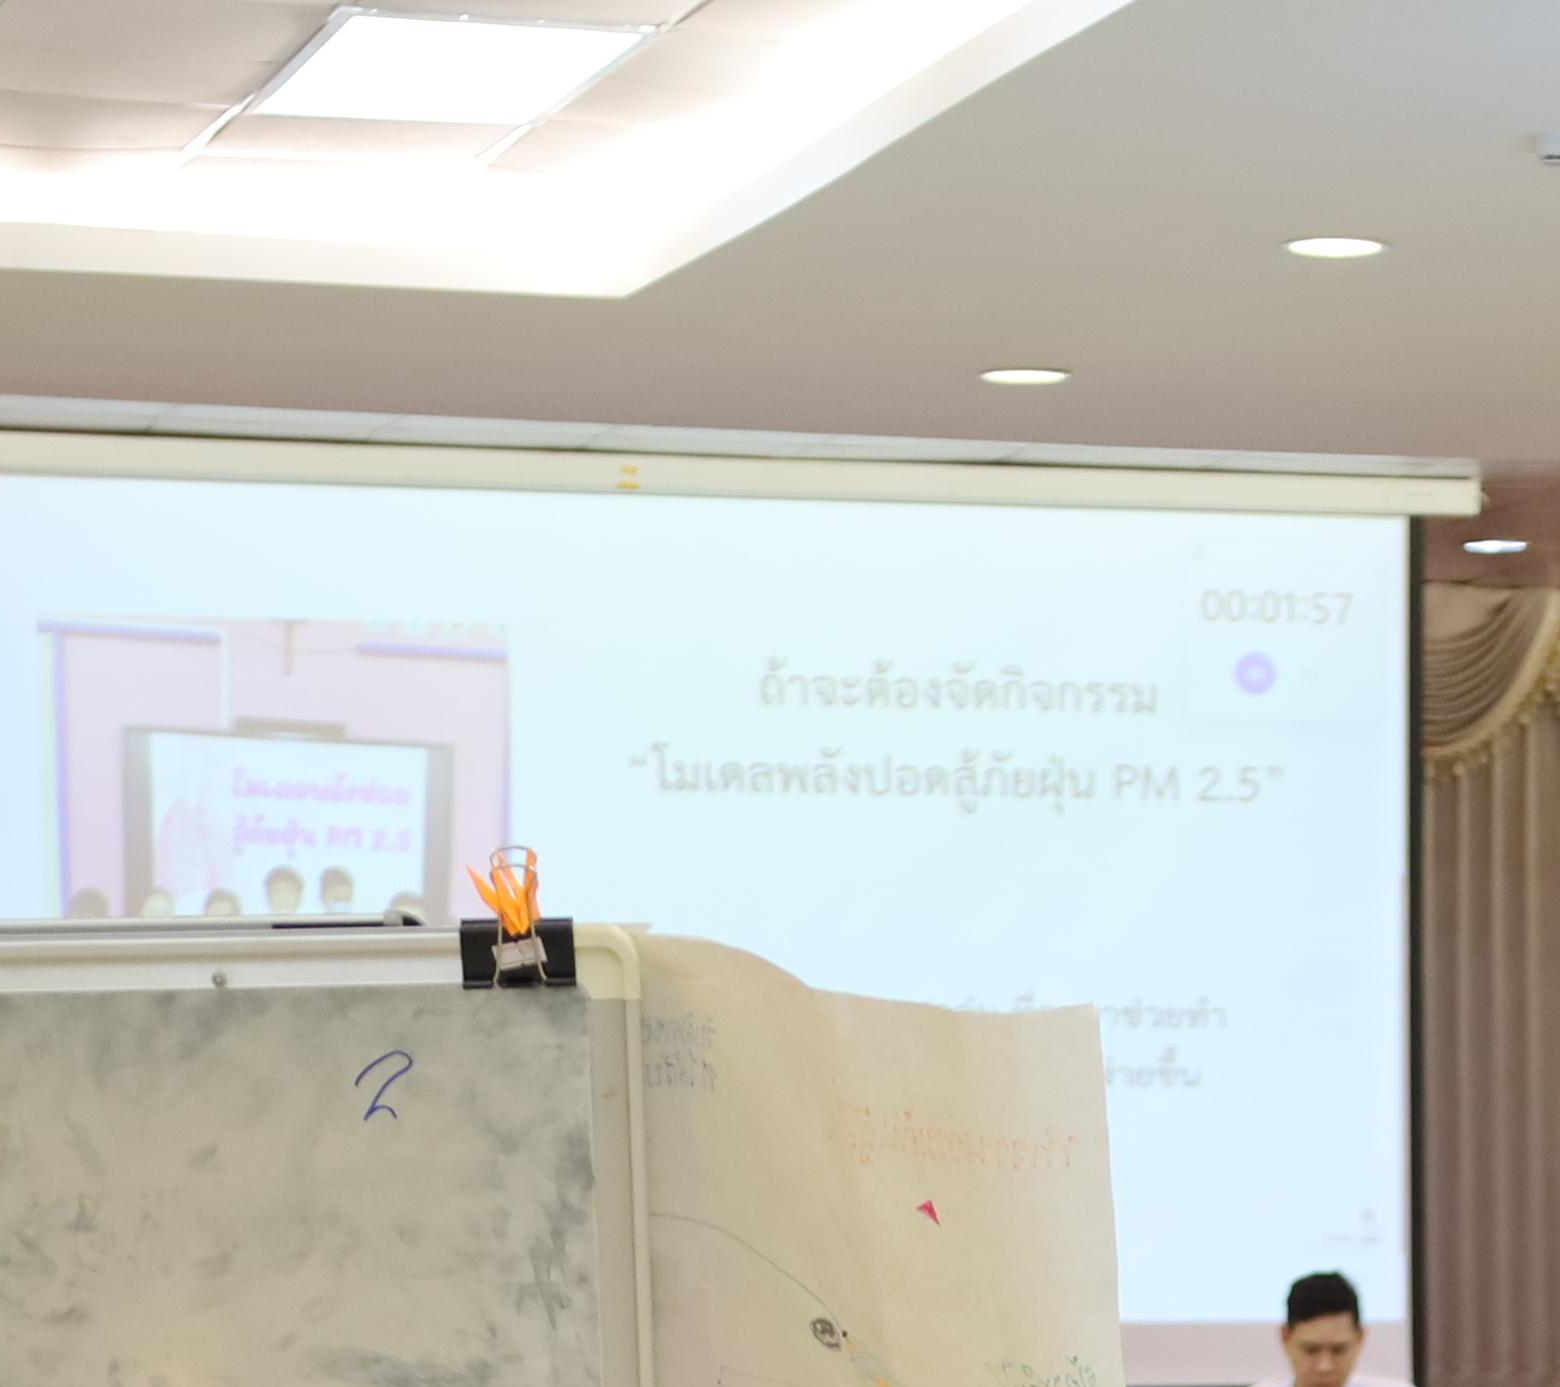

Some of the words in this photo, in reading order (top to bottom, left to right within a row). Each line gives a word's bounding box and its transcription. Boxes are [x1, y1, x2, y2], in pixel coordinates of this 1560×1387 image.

[1200, 587, 1355, 625] 00:01:57
[756, 657, 1159, 717] ถ้าจะต้องจัดกิจกรรม
[1112, 764, 1181, 802] PM
[354, 1049, 414, 1121] 2
